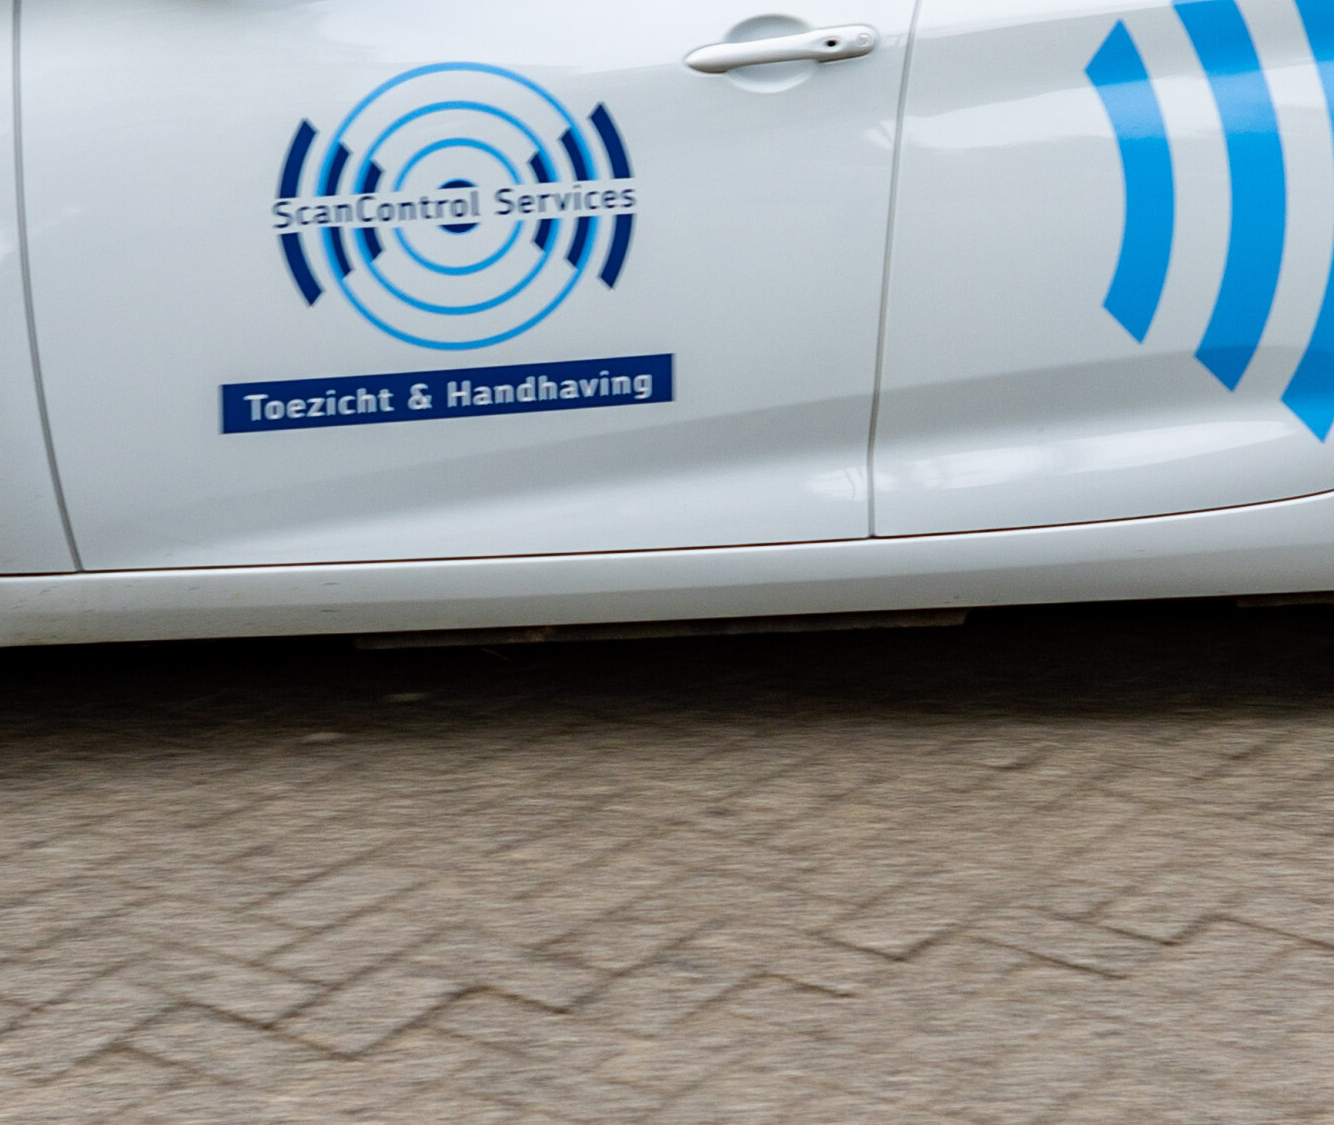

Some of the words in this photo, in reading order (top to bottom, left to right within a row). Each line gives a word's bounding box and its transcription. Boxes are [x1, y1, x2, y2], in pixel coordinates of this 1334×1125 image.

[273, 190, 480, 229] ScanControl
[494, 185, 637, 217] Services
[244, 387, 394, 422] Toezicht
[407, 383, 433, 410] &
[447, 370, 653, 408] Handhaving
